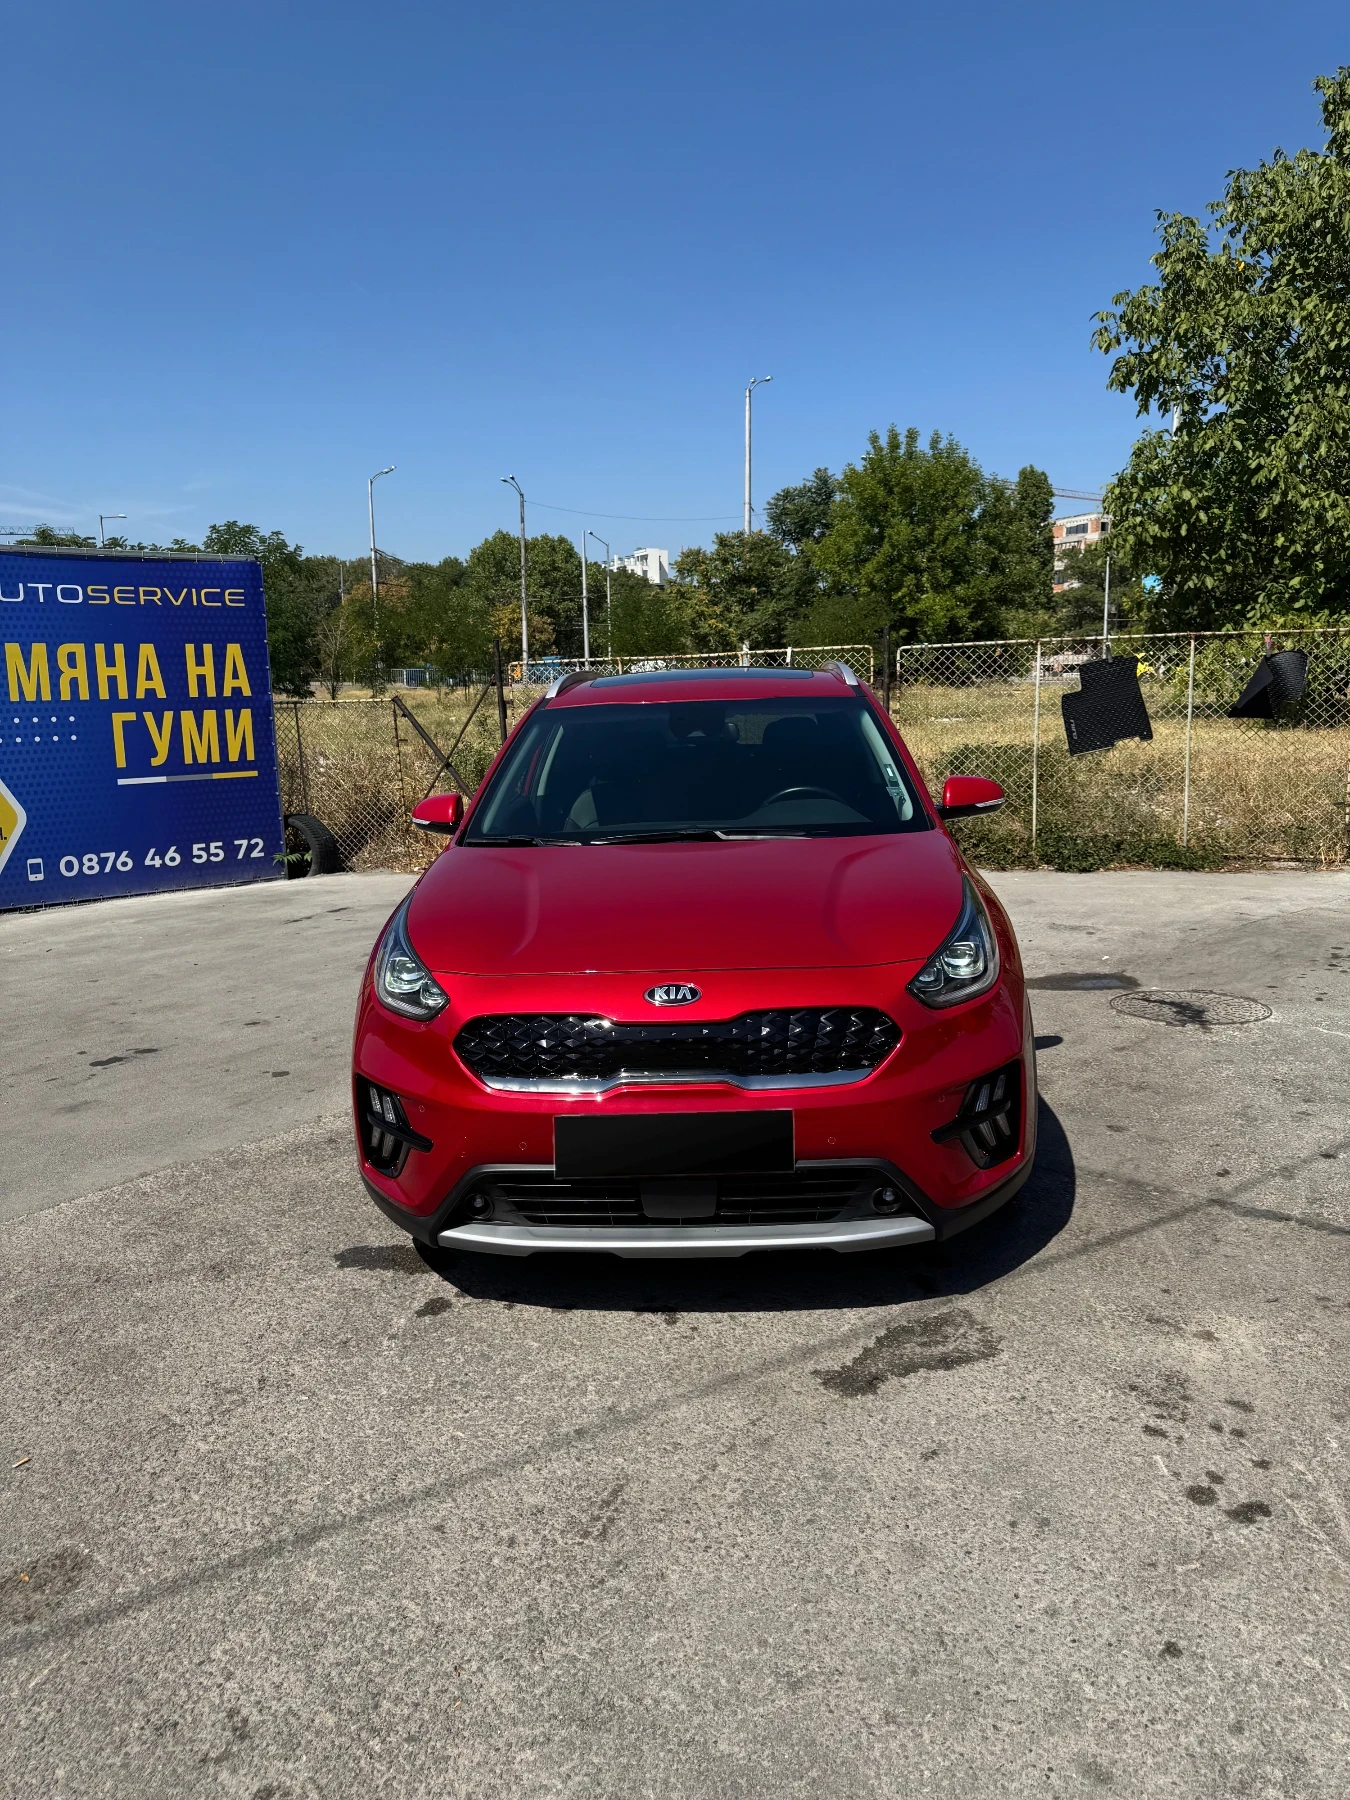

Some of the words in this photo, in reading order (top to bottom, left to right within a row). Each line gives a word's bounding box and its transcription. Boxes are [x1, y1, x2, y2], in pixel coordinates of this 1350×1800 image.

[5, 643, 166, 701] МЯНА
[185, 644, 251, 697] НА
[112, 709, 255, 768] ГУМИ
[60, 851, 133, 876] 0876
[145, 846, 180, 867] 46
[193, 842, 224, 863] 55
[234, 838, 264, 859] 72
[655, 987, 691, 1000] KIA
